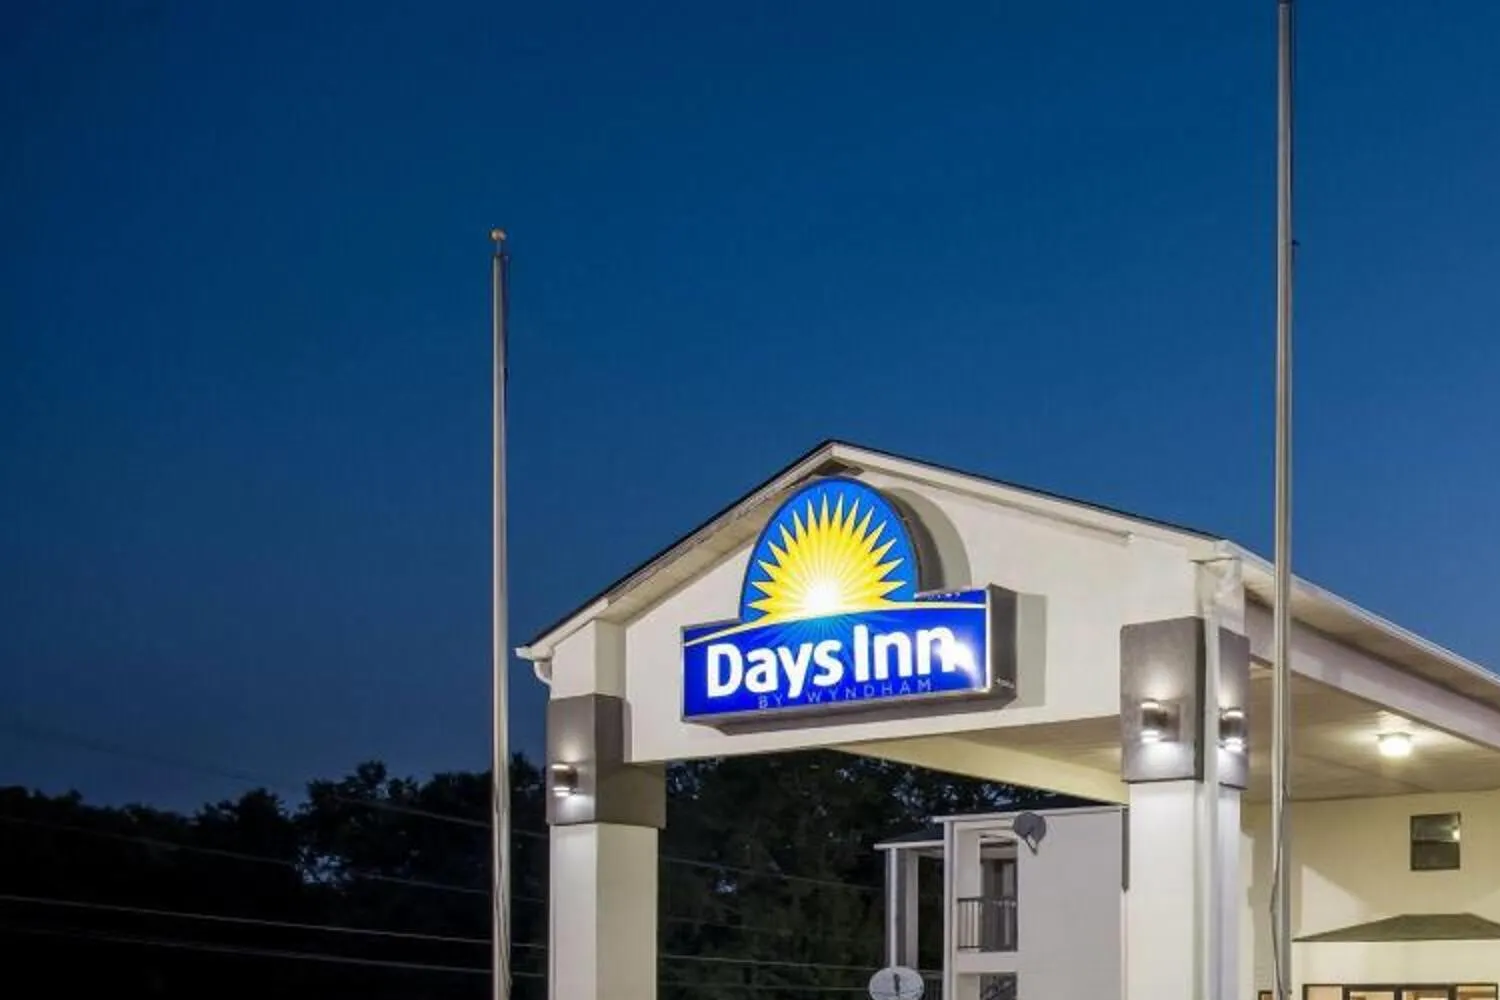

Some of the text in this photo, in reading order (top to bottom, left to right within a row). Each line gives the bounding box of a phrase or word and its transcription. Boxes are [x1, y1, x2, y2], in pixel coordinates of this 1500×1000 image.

[707, 624, 956, 698] Days Inn
[758, 679, 933, 709] BY WYNDHAM
